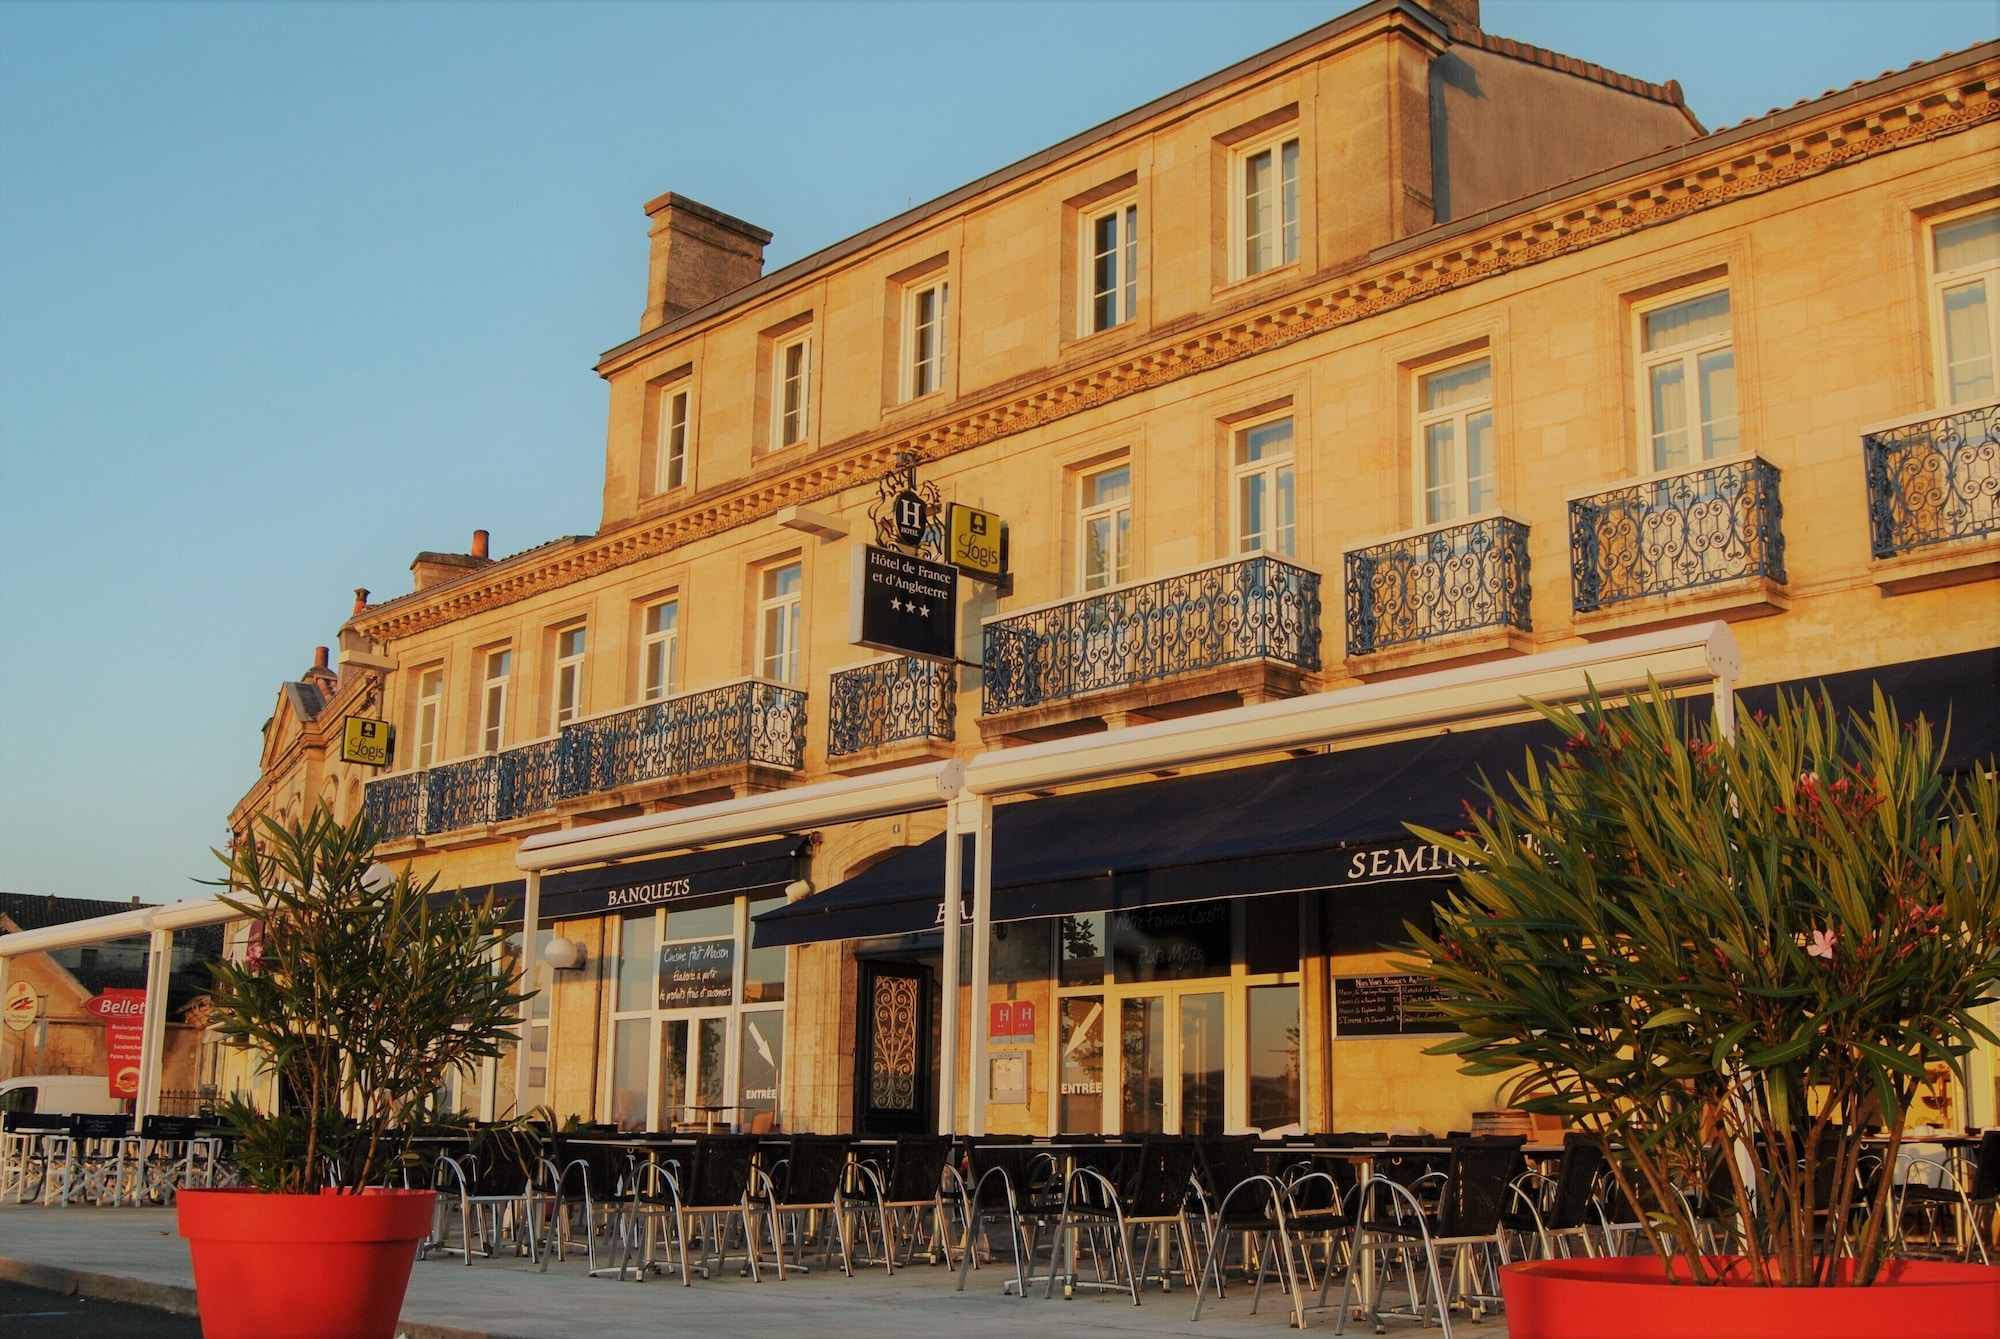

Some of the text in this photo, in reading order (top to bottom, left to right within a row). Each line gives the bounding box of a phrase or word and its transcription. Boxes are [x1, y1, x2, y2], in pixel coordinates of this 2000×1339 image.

[901, 499, 921, 528] H
[901, 526, 919, 537] HOTEL
[957, 534, 998, 567] Logis
[871, 552, 951, 584] Hôtel de France
[872, 572, 948, 599] et d'Angleterre
[348, 738, 385, 761] Logis
[608, 879, 690, 905] BANQUETS
[664, 948, 687, 963] Cuisine
[703, 944, 729, 960] Maison
[1000, 1009, 1009, 1021] H
[1022, 1008, 1031, 1020] H
[746, 1086, 777, 1100] ENTRÉE
[1061, 1080, 1103, 1095] ENTRÉE
